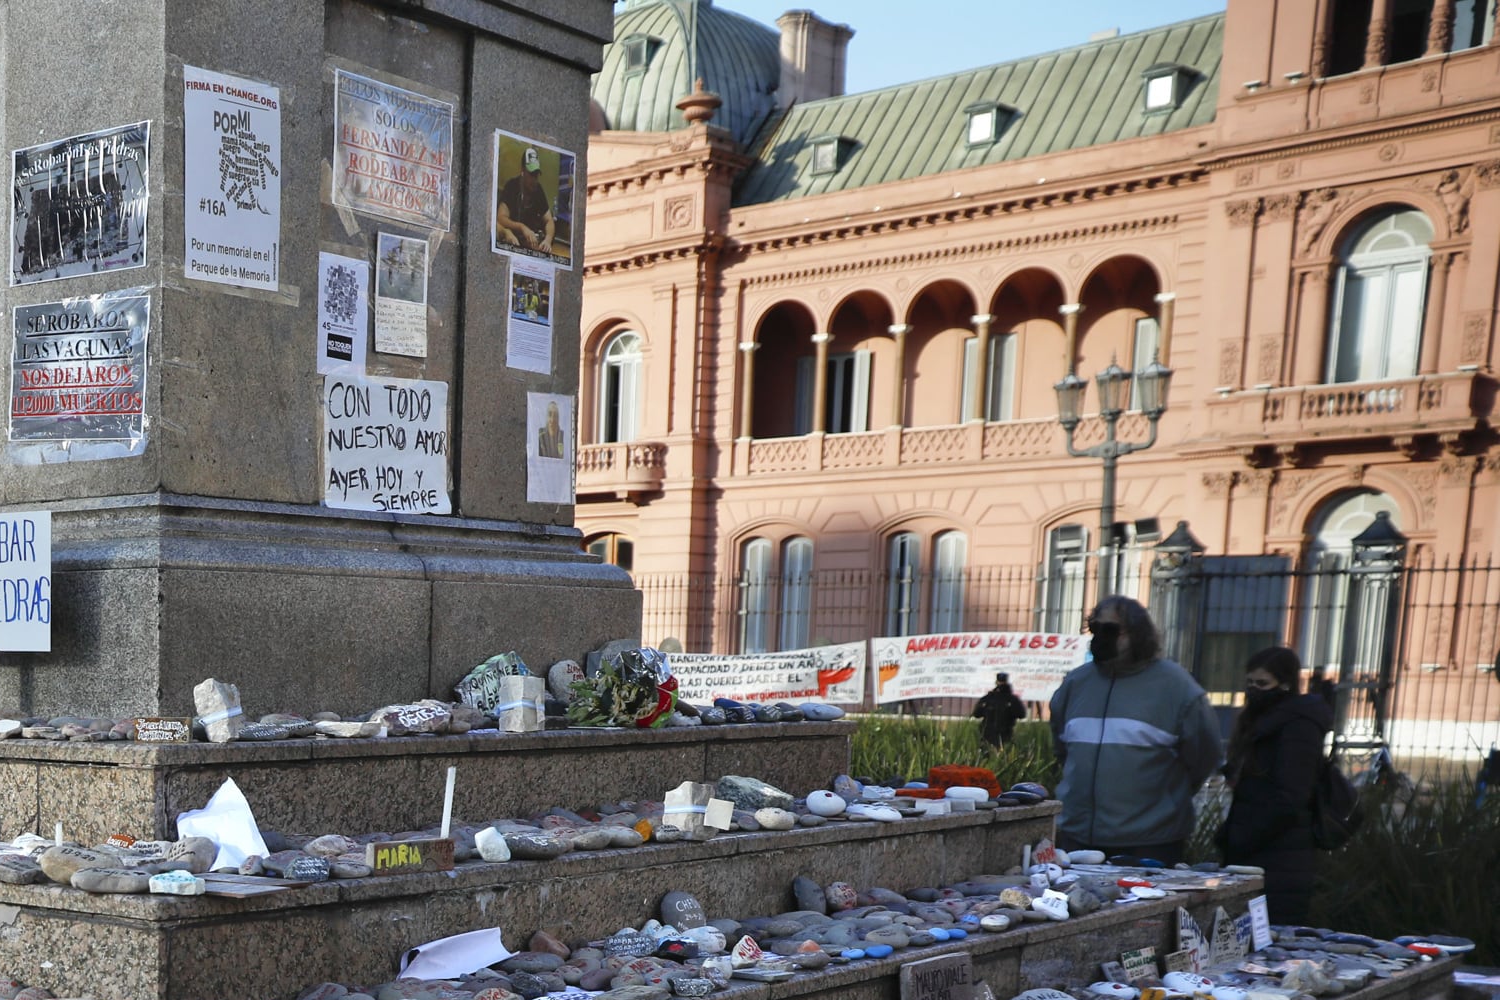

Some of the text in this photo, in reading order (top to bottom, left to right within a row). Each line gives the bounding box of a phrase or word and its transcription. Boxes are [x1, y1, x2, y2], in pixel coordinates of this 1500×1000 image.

[186, 81, 277, 110] FIRMA EN CHANGE.ORG
[214, 109, 250, 135] POR MI
[375, 110, 416, 132] SOLOS
[238, 130, 256, 141] abuelo
[342, 124, 428, 161] FERNÁNDEZ
[254, 142, 270, 153] amiga
[349, 152, 438, 190] RODEABA DE
[200, 198, 226, 216] #16A
[191, 238, 270, 262] Por un memorial en el
[191, 260, 270, 282] Parque de la Memoria
[27, 315, 43, 333] SE
[23, 337, 132, 359] LAS VACUNAS
[21, 364, 132, 386] NOS DEJARON
[13, 392, 142, 412] 112000 MUERTOS
[329, 382, 431, 422] CON TODO
[329, 424, 447, 456] NUESTRO AMOR
[376, 466, 424, 492] HOY Y
[906, 635, 981, 654] AUMENTO
[745, 690, 789, 701] vergüenza
[377, 844, 422, 869] MARIA
